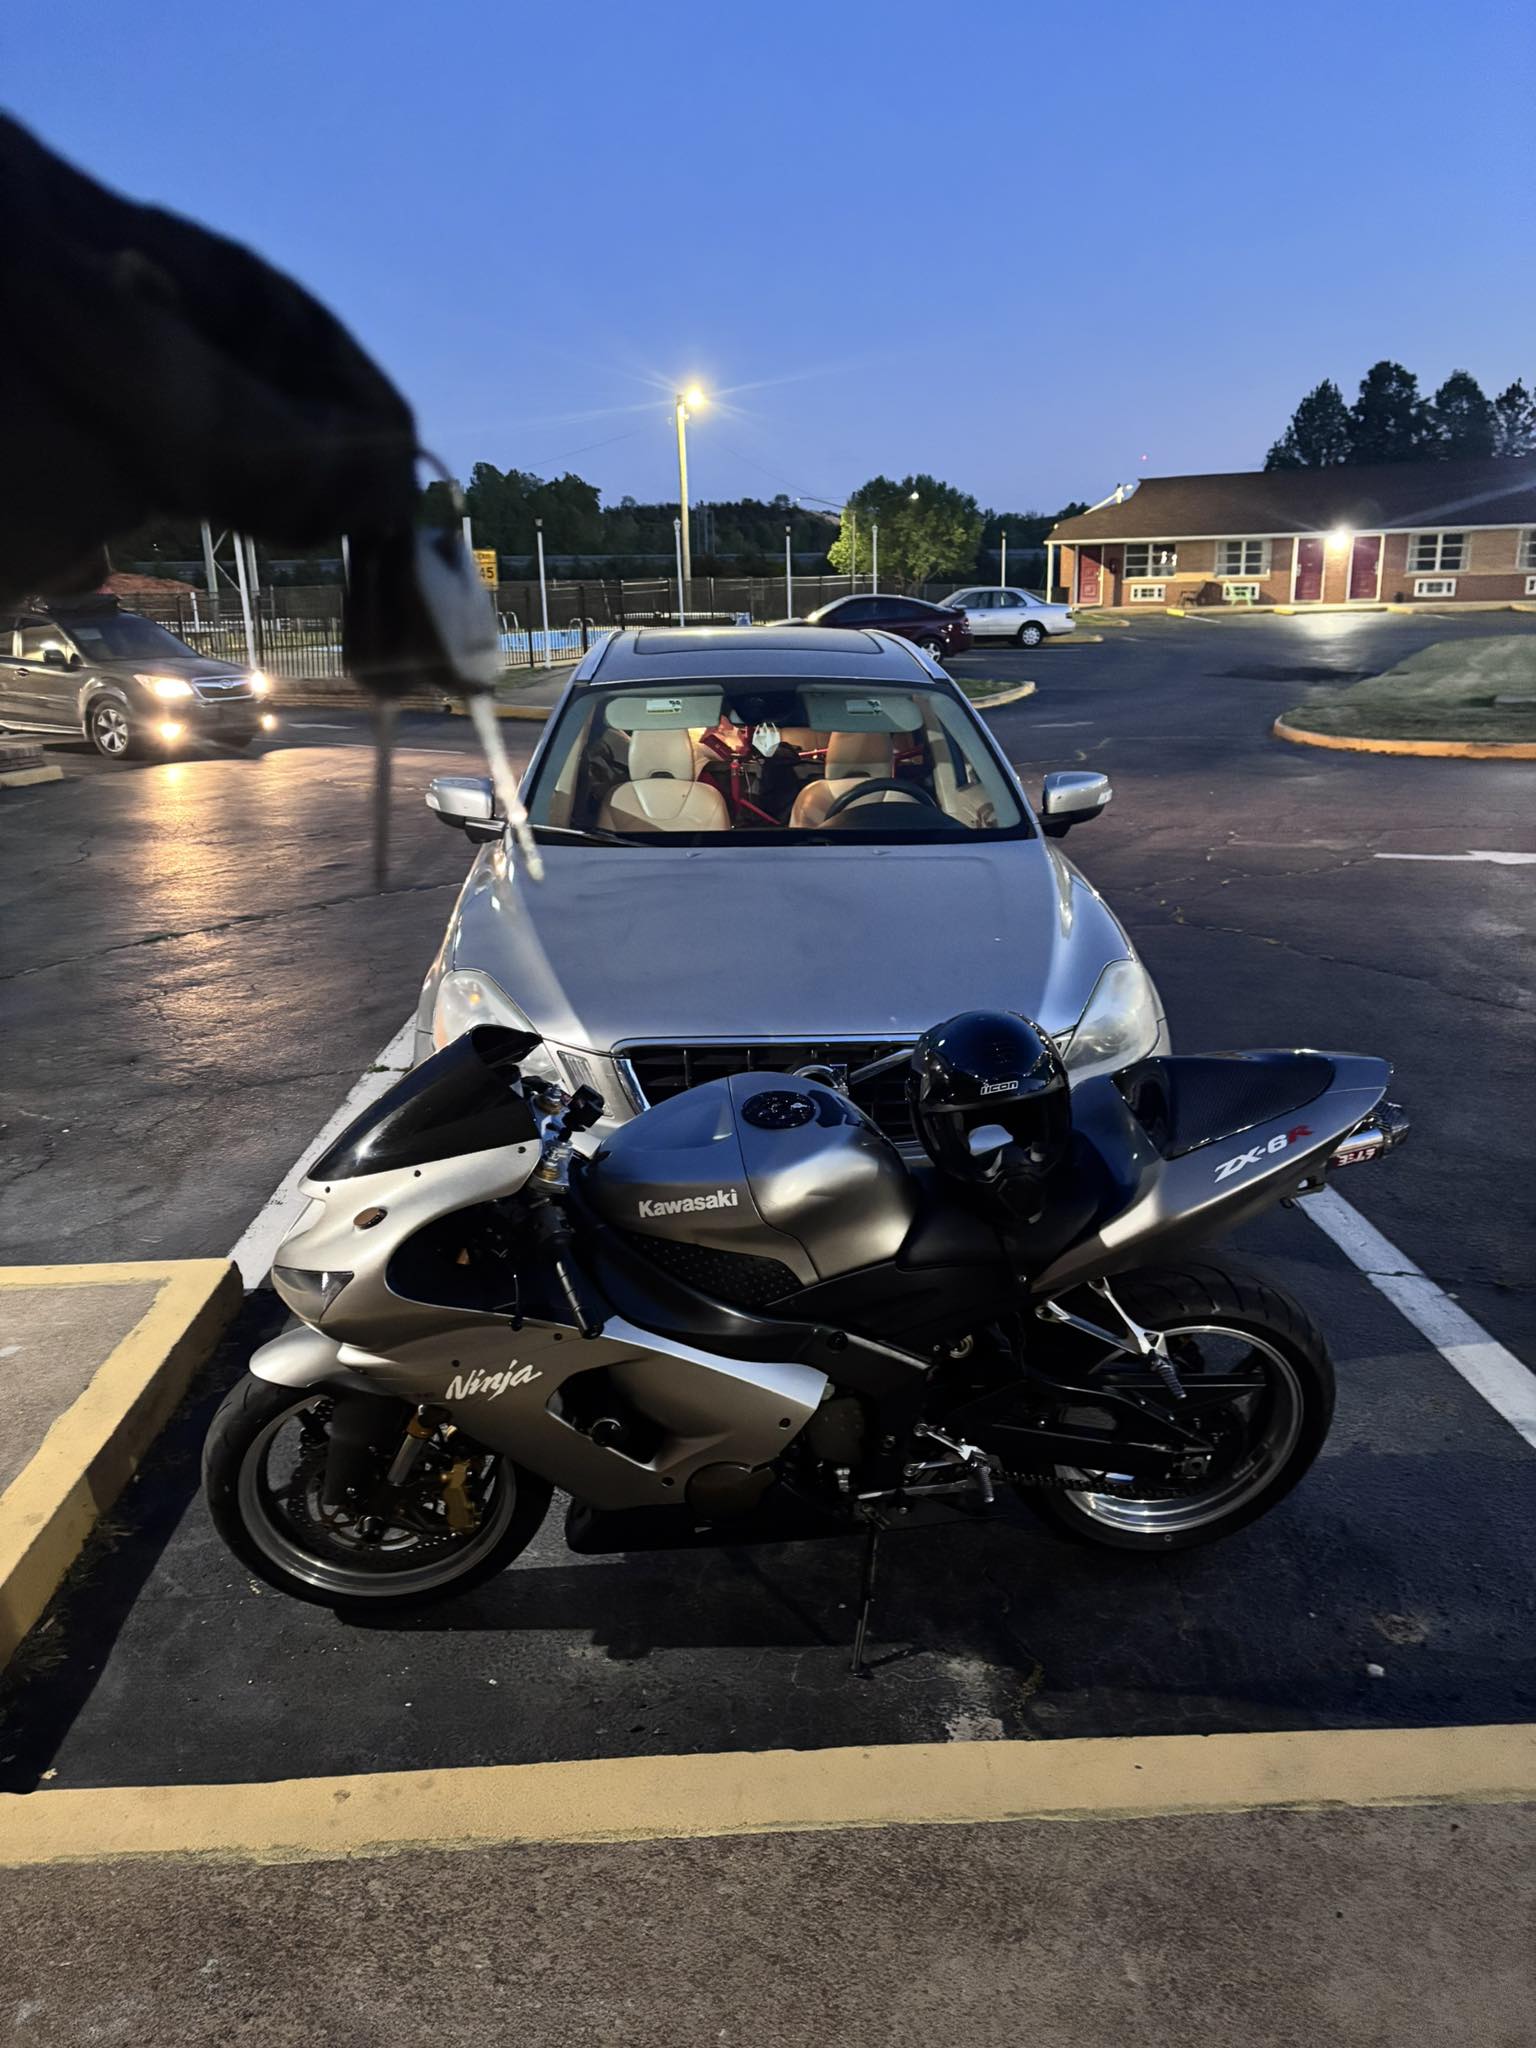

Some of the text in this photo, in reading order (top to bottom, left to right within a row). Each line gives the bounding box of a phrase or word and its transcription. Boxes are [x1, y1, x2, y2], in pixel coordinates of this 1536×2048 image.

[1214, 1125, 1314, 1183] ZX-6R
[638, 1188, 738, 1218] Kawasaki
[445, 1359, 543, 1401] Ninja
